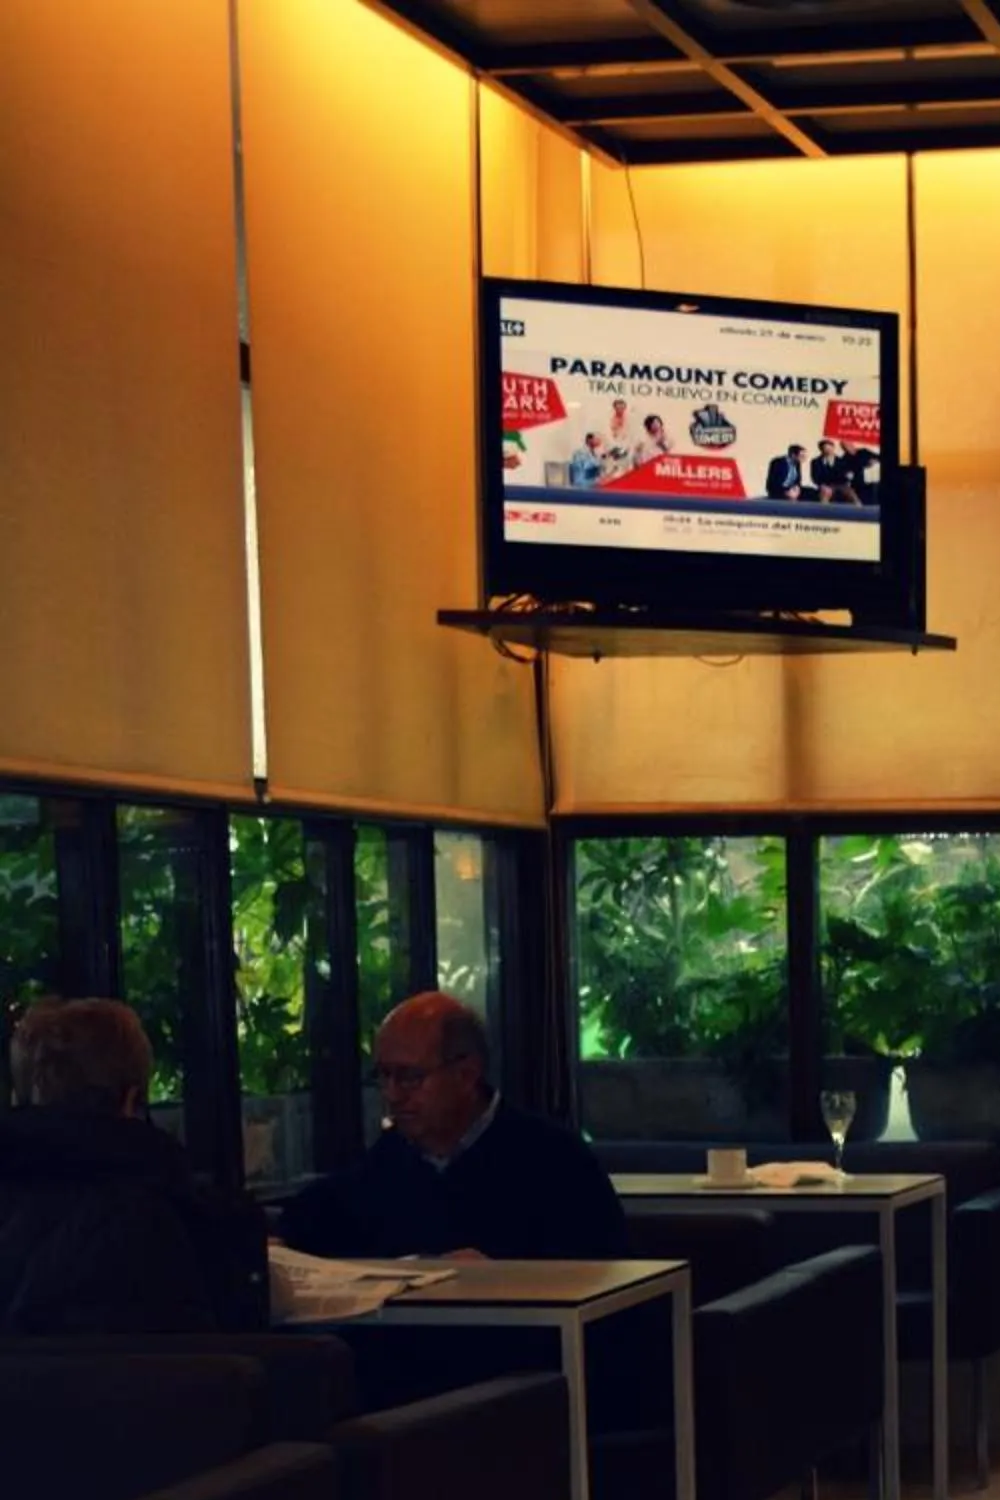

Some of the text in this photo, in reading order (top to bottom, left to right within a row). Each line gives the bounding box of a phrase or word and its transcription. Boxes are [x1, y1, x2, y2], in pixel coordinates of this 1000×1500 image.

[550, 357, 849, 396] PARAMOUNT COMEDY
[588, 379, 820, 409] TRAE LO NUEVO EN COMEDIA
[655, 461, 733, 481] MILLERS
